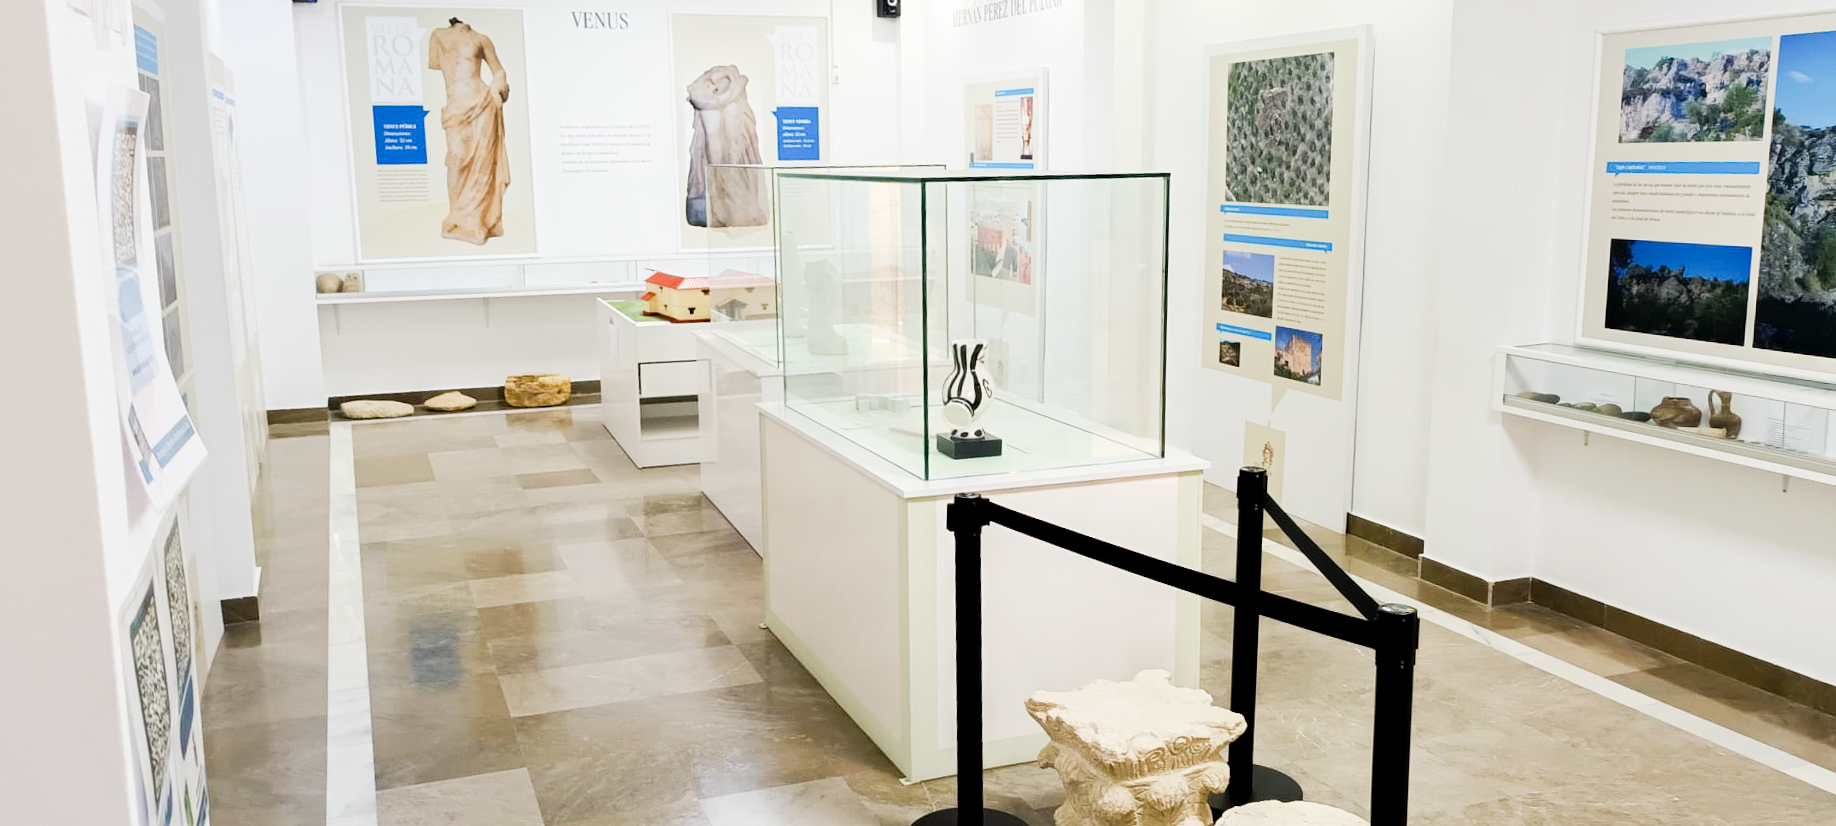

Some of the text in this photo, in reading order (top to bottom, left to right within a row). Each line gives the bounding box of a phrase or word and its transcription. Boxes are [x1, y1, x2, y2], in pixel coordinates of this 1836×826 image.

[571, 11, 629, 30] VENUS
[952, 1, 982, 28] HERNÁN
[1010, 0, 1027, 17] DEL
